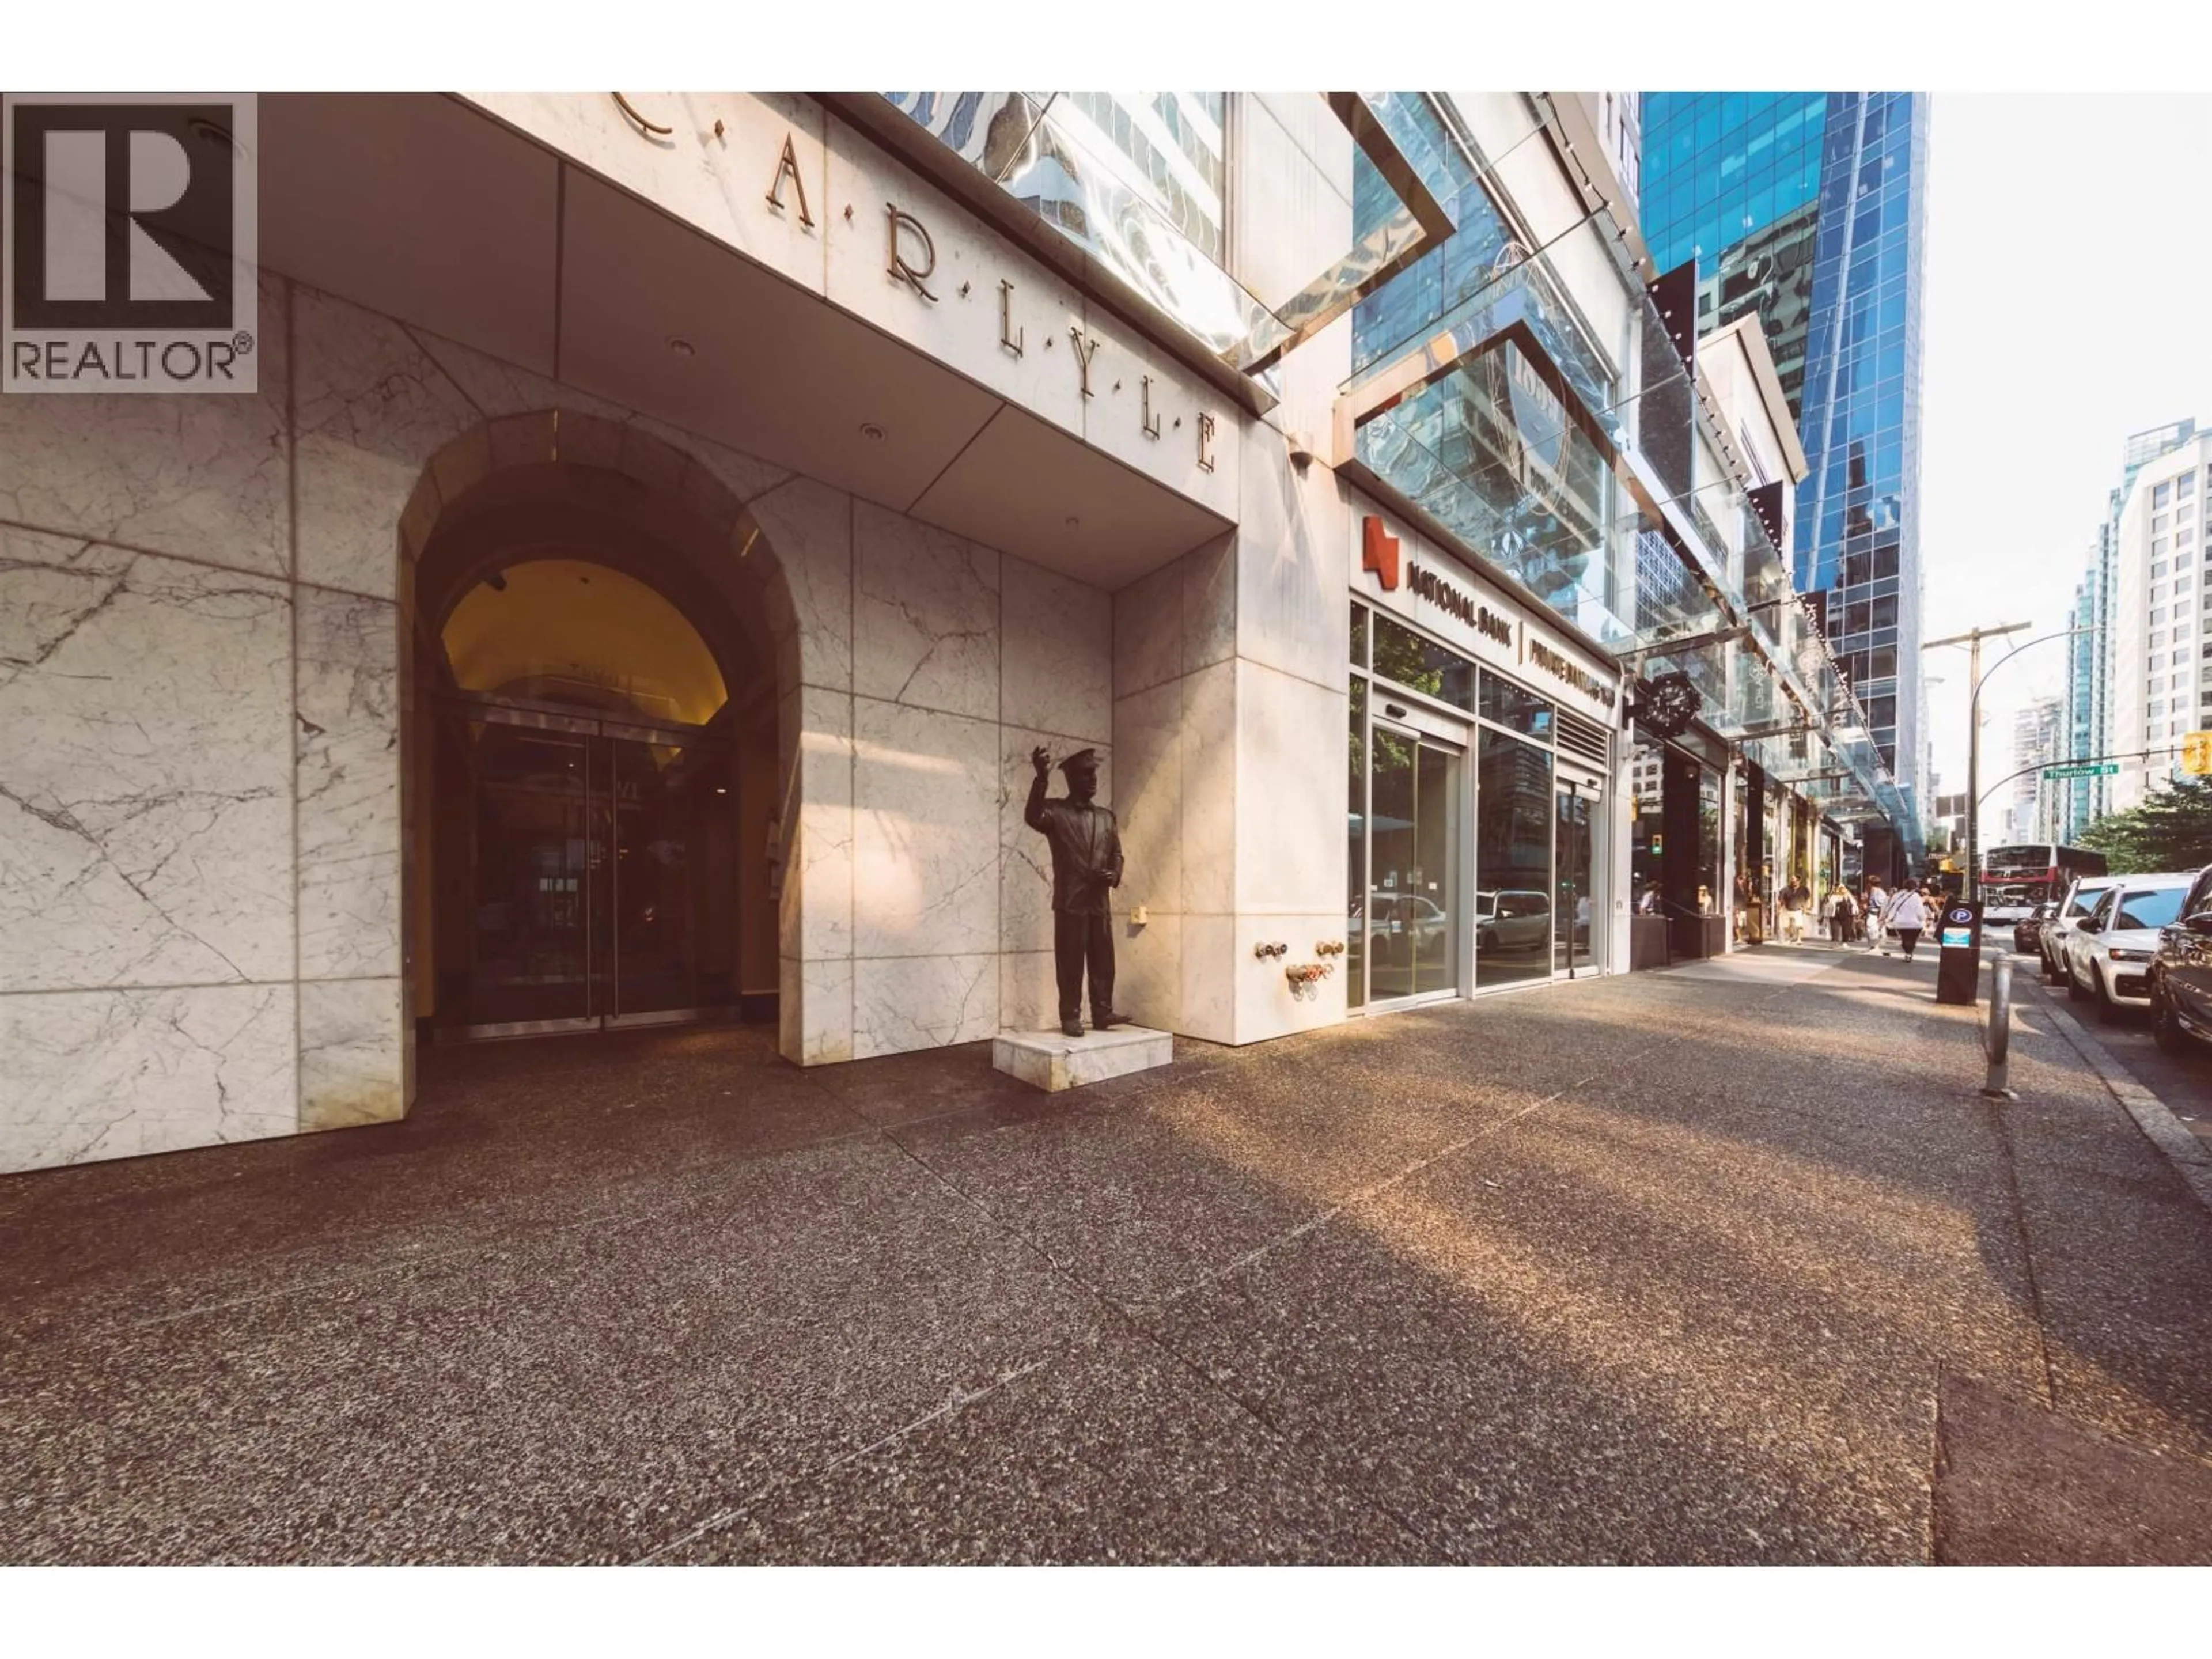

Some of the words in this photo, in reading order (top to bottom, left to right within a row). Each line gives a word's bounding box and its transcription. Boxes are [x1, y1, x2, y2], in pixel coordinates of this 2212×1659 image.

[1407, 560, 1477, 628] NATIONAL
[1478, 606, 1512, 649] BANK
[2049, 768, 2095, 778] Thurlow
[2100, 766, 2113, 774] St
